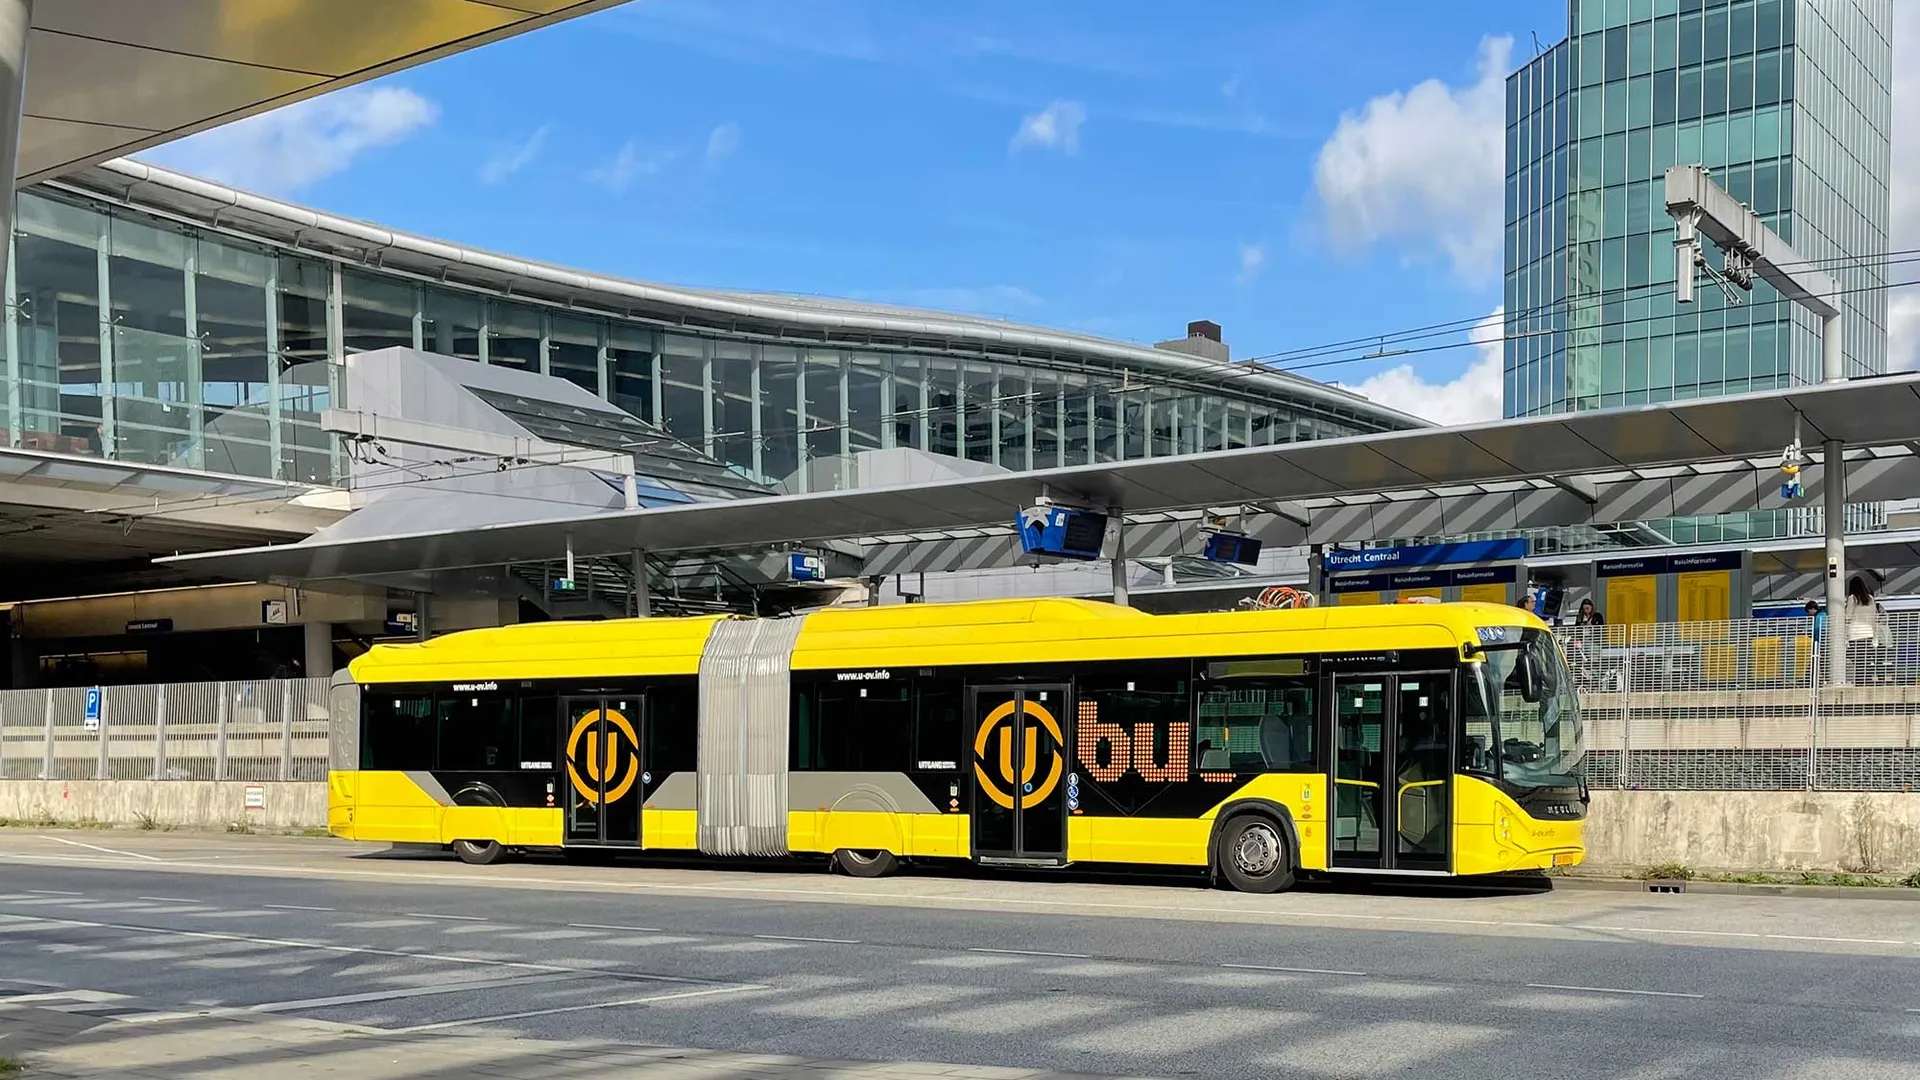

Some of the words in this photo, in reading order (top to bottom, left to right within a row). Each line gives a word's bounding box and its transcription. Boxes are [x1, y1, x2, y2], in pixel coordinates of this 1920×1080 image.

[1330, 554, 1362, 564] Utrecht
[1364, 551, 1400, 562] Centraal
[1674, 557, 1717, 566] Reisinformatie
[1394, 575, 1431, 583] Reisinformatie
[1457, 571, 1495, 579] Reisinformatie
[1334, 579, 1370, 587] Reisinformatie
[837, 669, 890, 681] www.u-ov.info
[453, 681, 498, 691] www.u-ov.info
[89, 692, 96, 709] P
